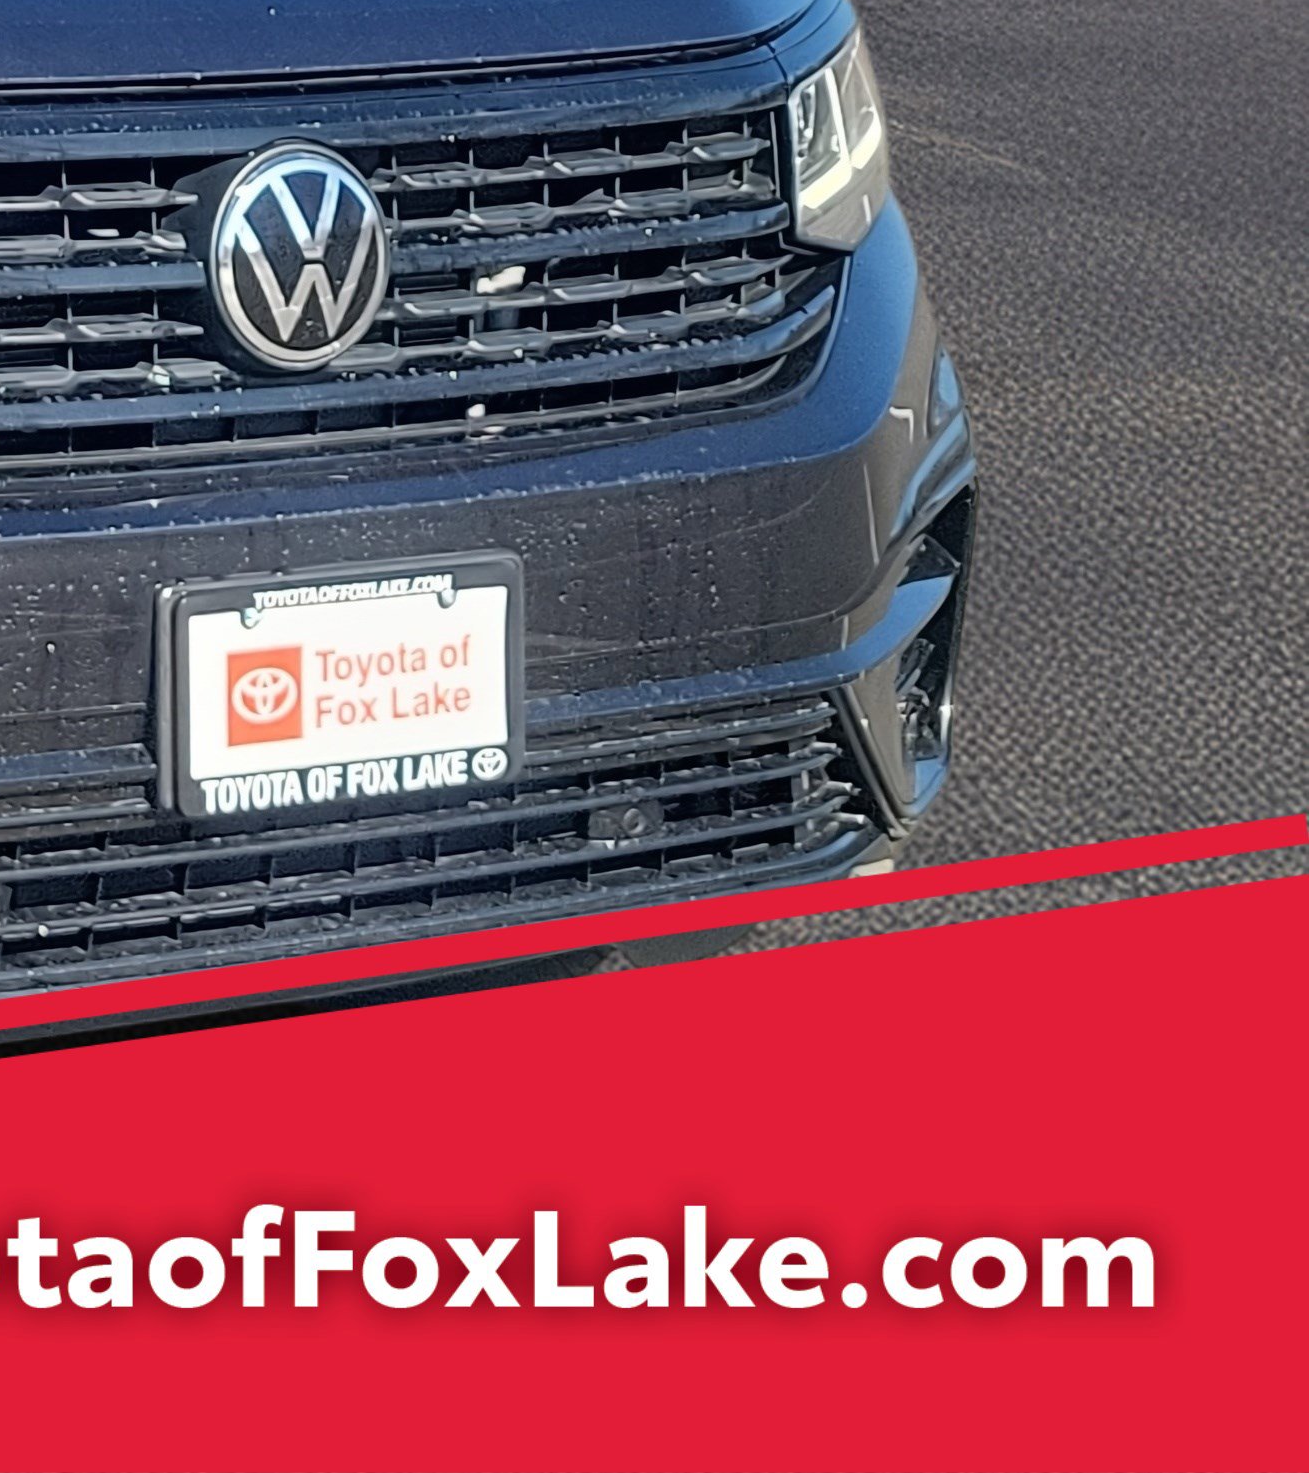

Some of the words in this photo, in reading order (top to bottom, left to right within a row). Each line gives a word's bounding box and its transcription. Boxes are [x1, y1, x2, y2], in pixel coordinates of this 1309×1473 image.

[252, 573, 453, 609] TOYOTAOFFOXLAKE.COM
[314, 641, 427, 687] Toyota
[440, 634, 471, 668] of
[314, 694, 378, 728] Fox
[391, 681, 472, 720] Lake
[201, 771, 304, 814] TOYOTA
[306, 764, 343, 801] OF
[347, 758, 400, 796] FOX
[402, 750, 469, 790] LAKE
